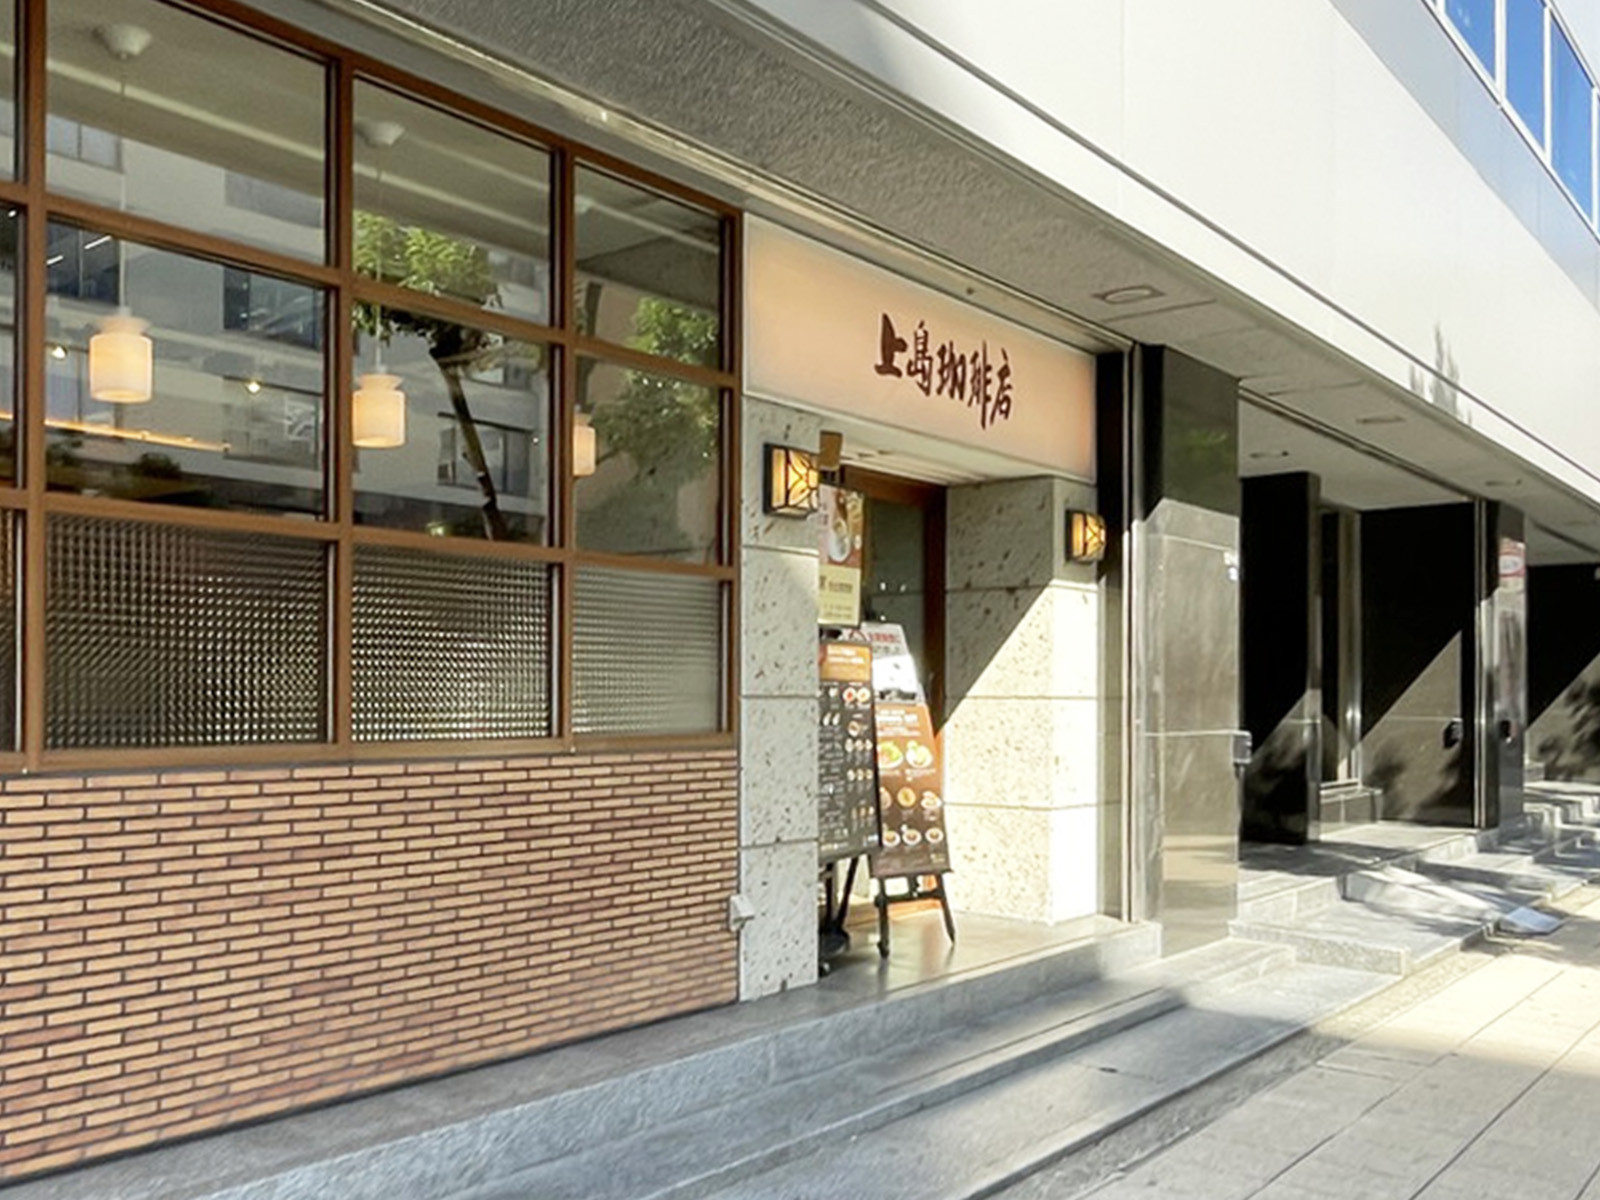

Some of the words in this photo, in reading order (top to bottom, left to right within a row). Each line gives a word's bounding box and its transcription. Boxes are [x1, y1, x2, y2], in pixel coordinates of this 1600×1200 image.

[874, 313, 1014, 430] 上島珈琲店
